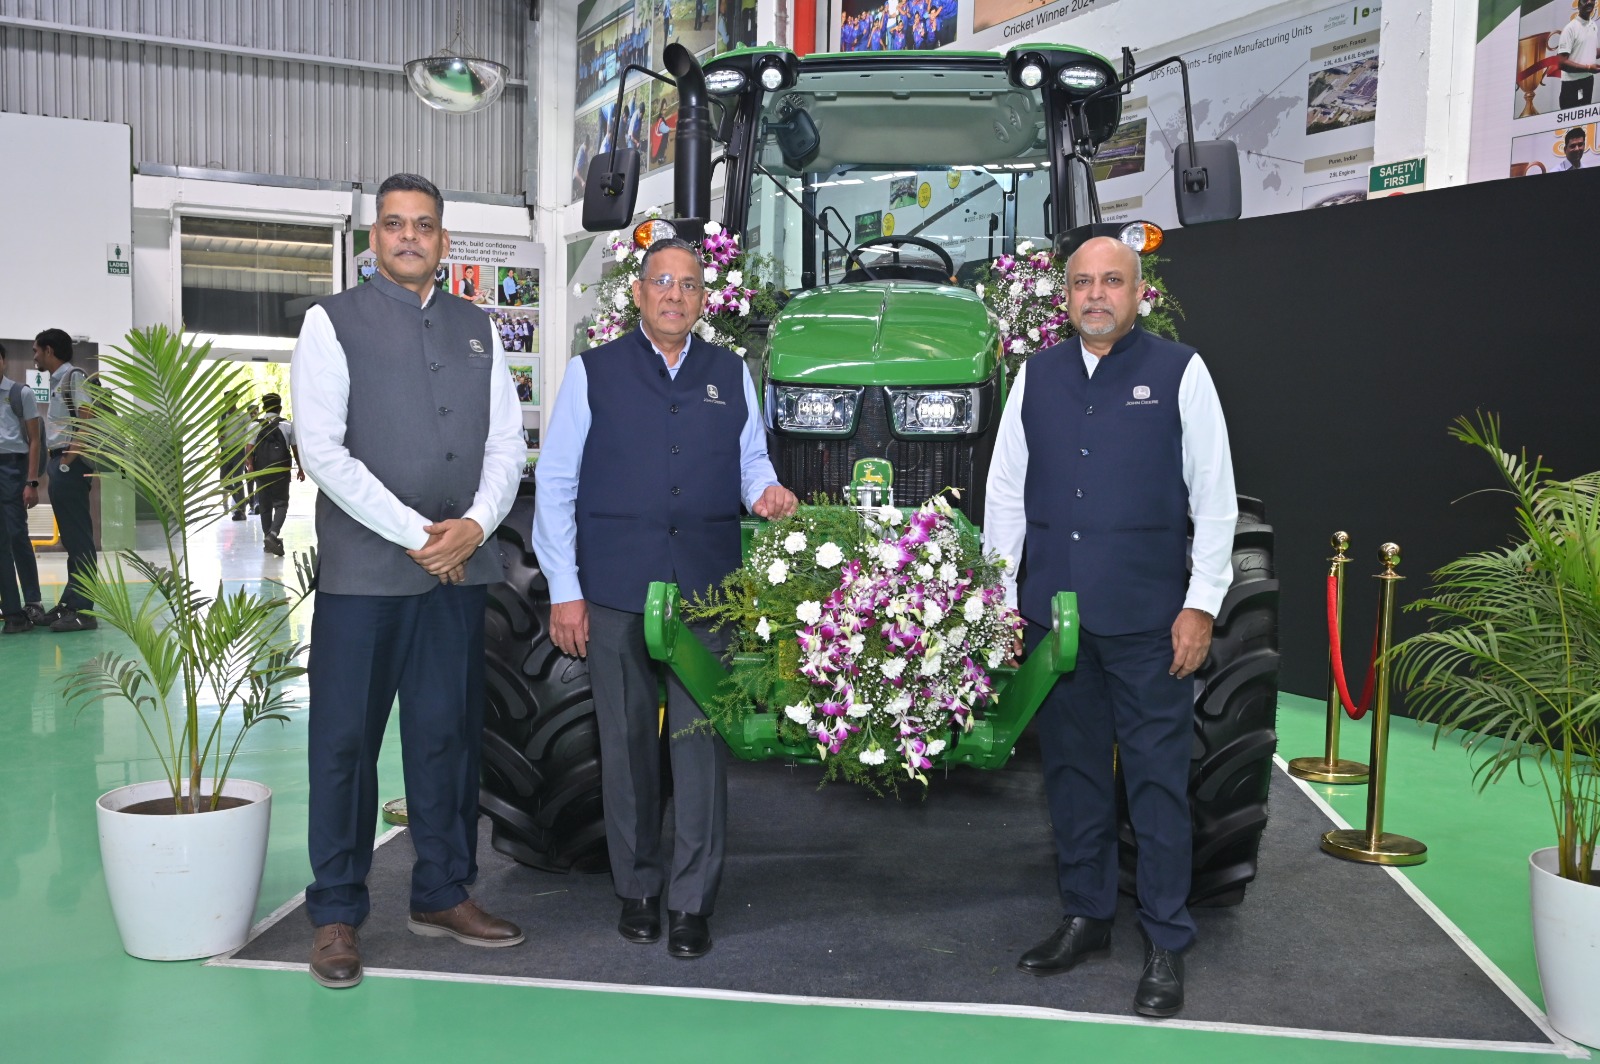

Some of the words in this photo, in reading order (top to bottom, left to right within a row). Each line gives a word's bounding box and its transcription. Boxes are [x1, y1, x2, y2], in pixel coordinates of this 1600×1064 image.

[1004, 17, 1034, 38] Cricket
[1036, 5, 1069, 26] Winner
[1208, 50, 1233, 65] Engine
[1234, 33, 1290, 56] Manufacturing
[1292, 24, 1313, 39] Units
[1557, 106, 1600, 123] SHUBHA
[1380, 162, 1415, 177] SAFETY
[1384, 175, 1410, 188] FIRST
[450, 240, 468, 248] twork,
[485, 241, 517, 250] confidence
[449, 254, 490, 263] Manufacturing
